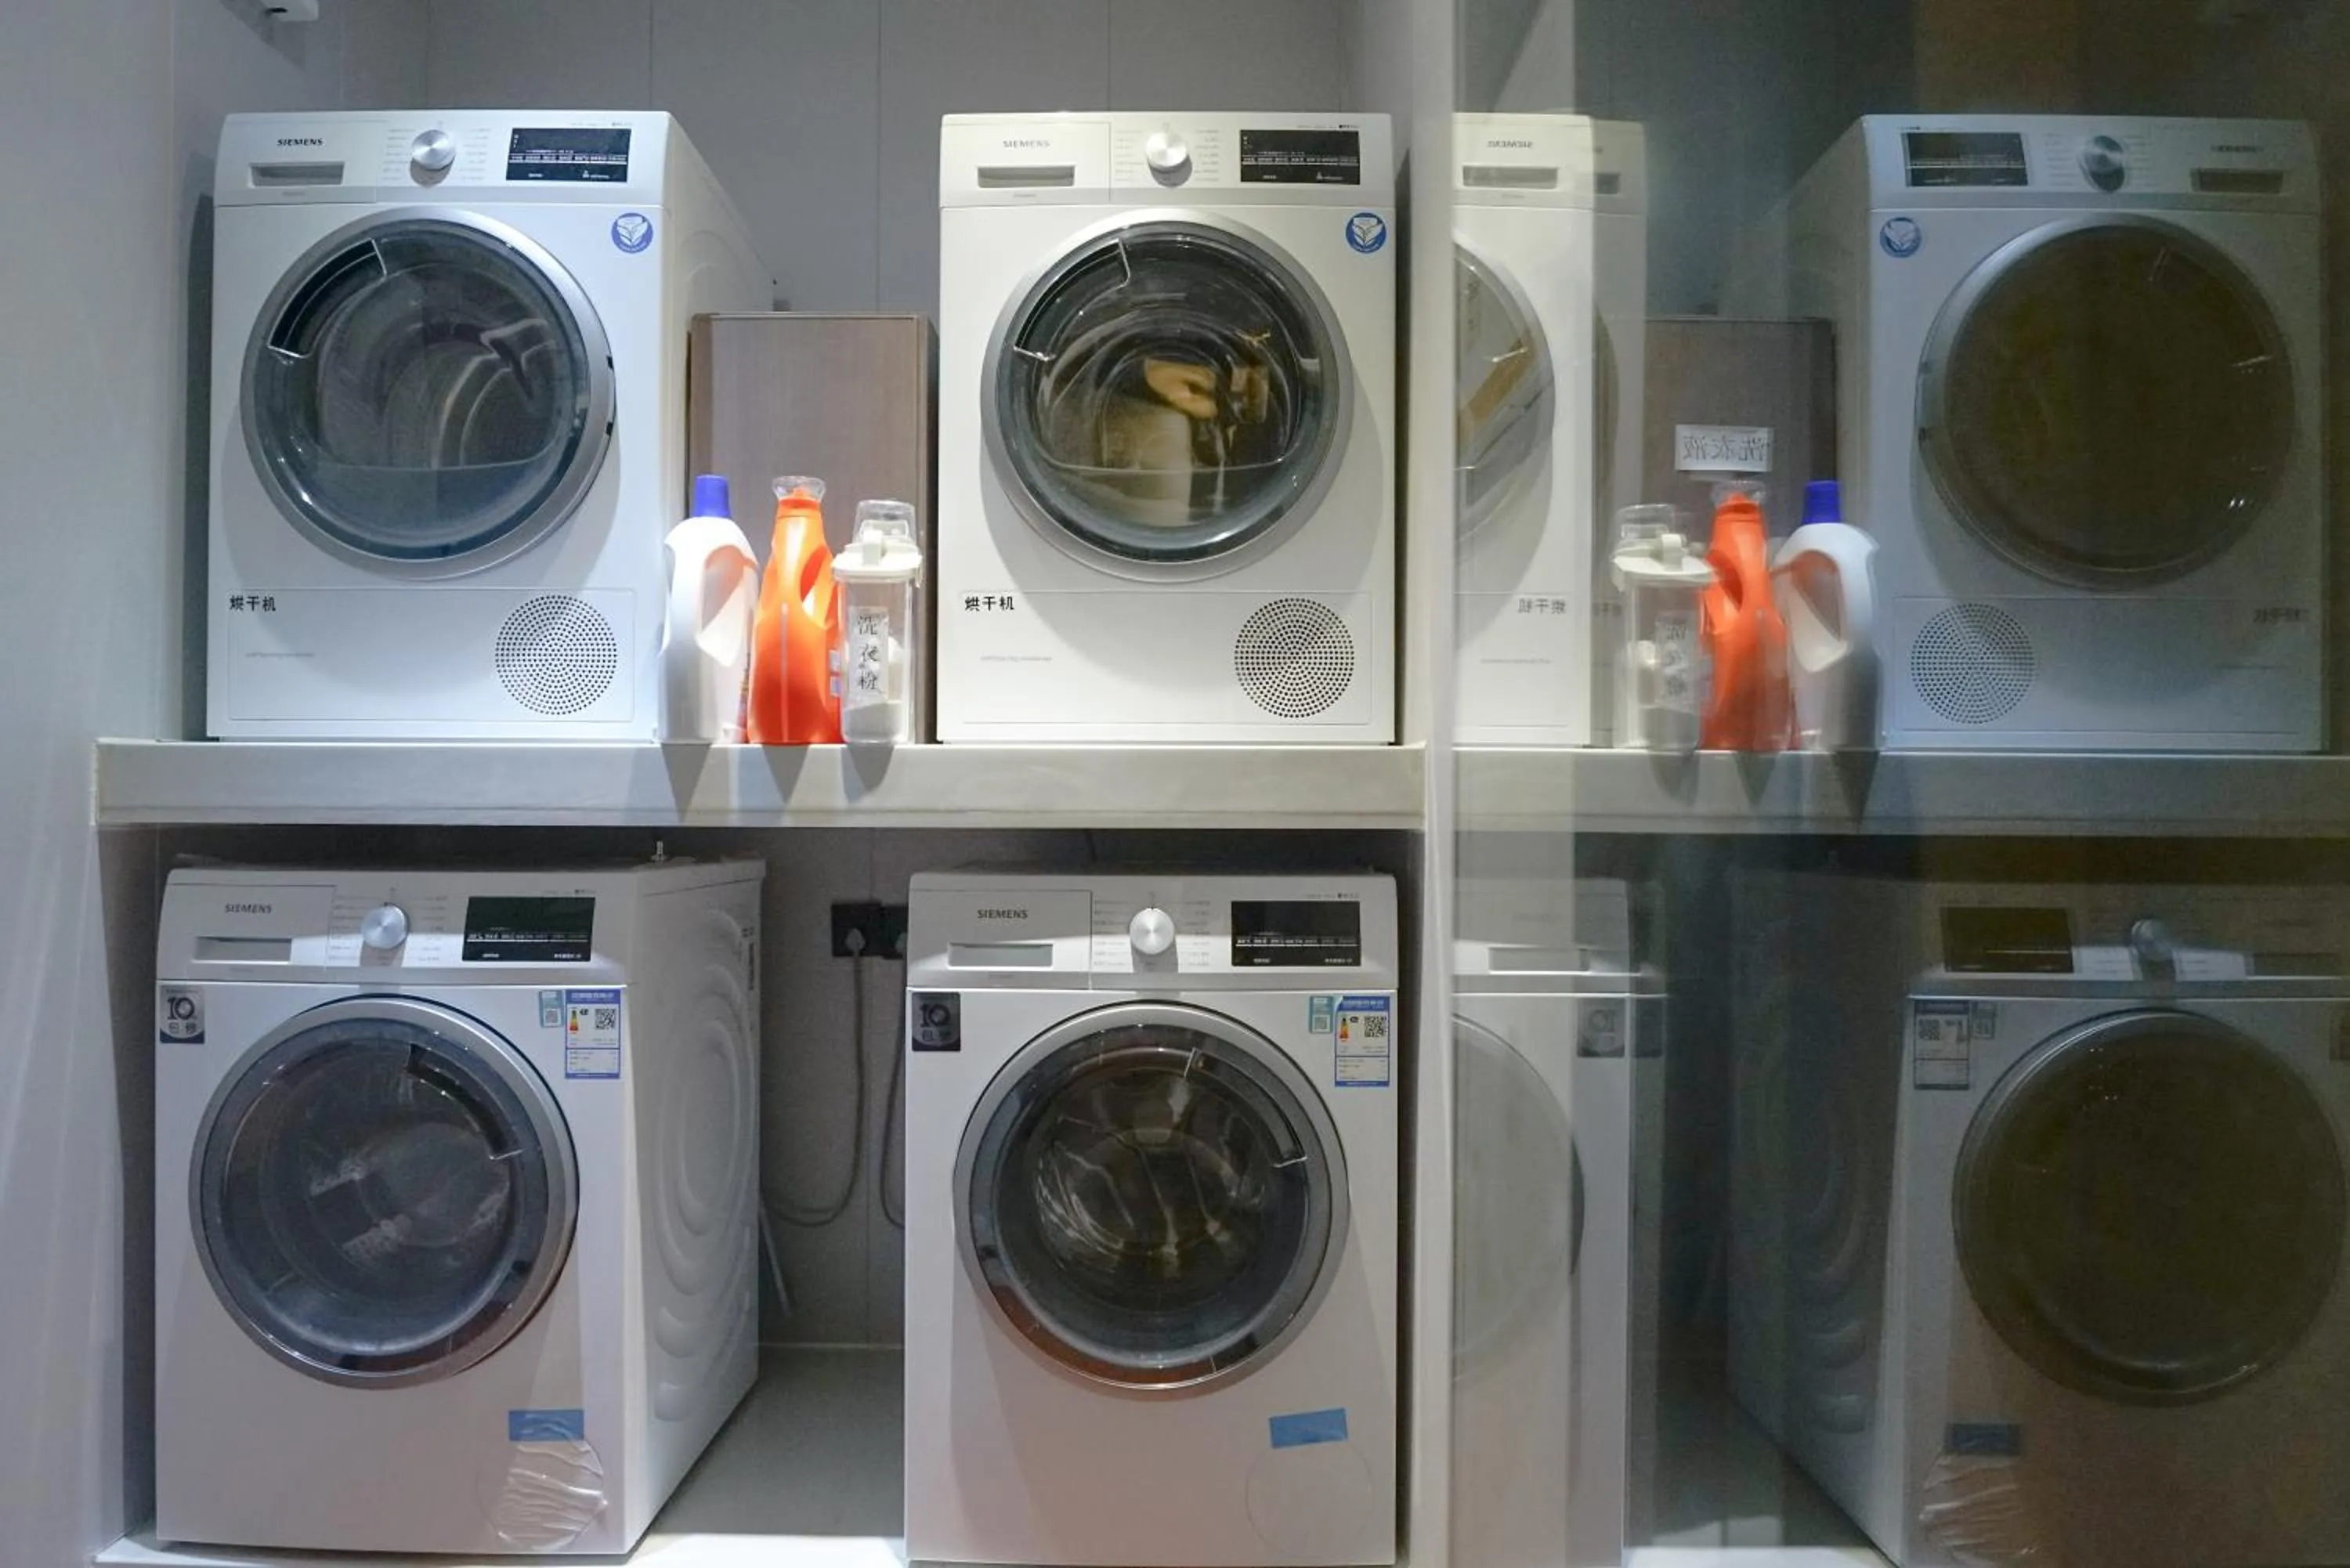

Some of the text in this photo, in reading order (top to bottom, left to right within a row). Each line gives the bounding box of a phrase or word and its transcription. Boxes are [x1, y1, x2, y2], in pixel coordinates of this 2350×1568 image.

[277, 138, 324, 146] SIEMENS
[229, 595, 277, 612] 烘干机
[964, 596, 1015, 612] 烘干机
[225, 903, 273, 914] SIEMENS
[977, 909, 1029, 919] SIEMENS
